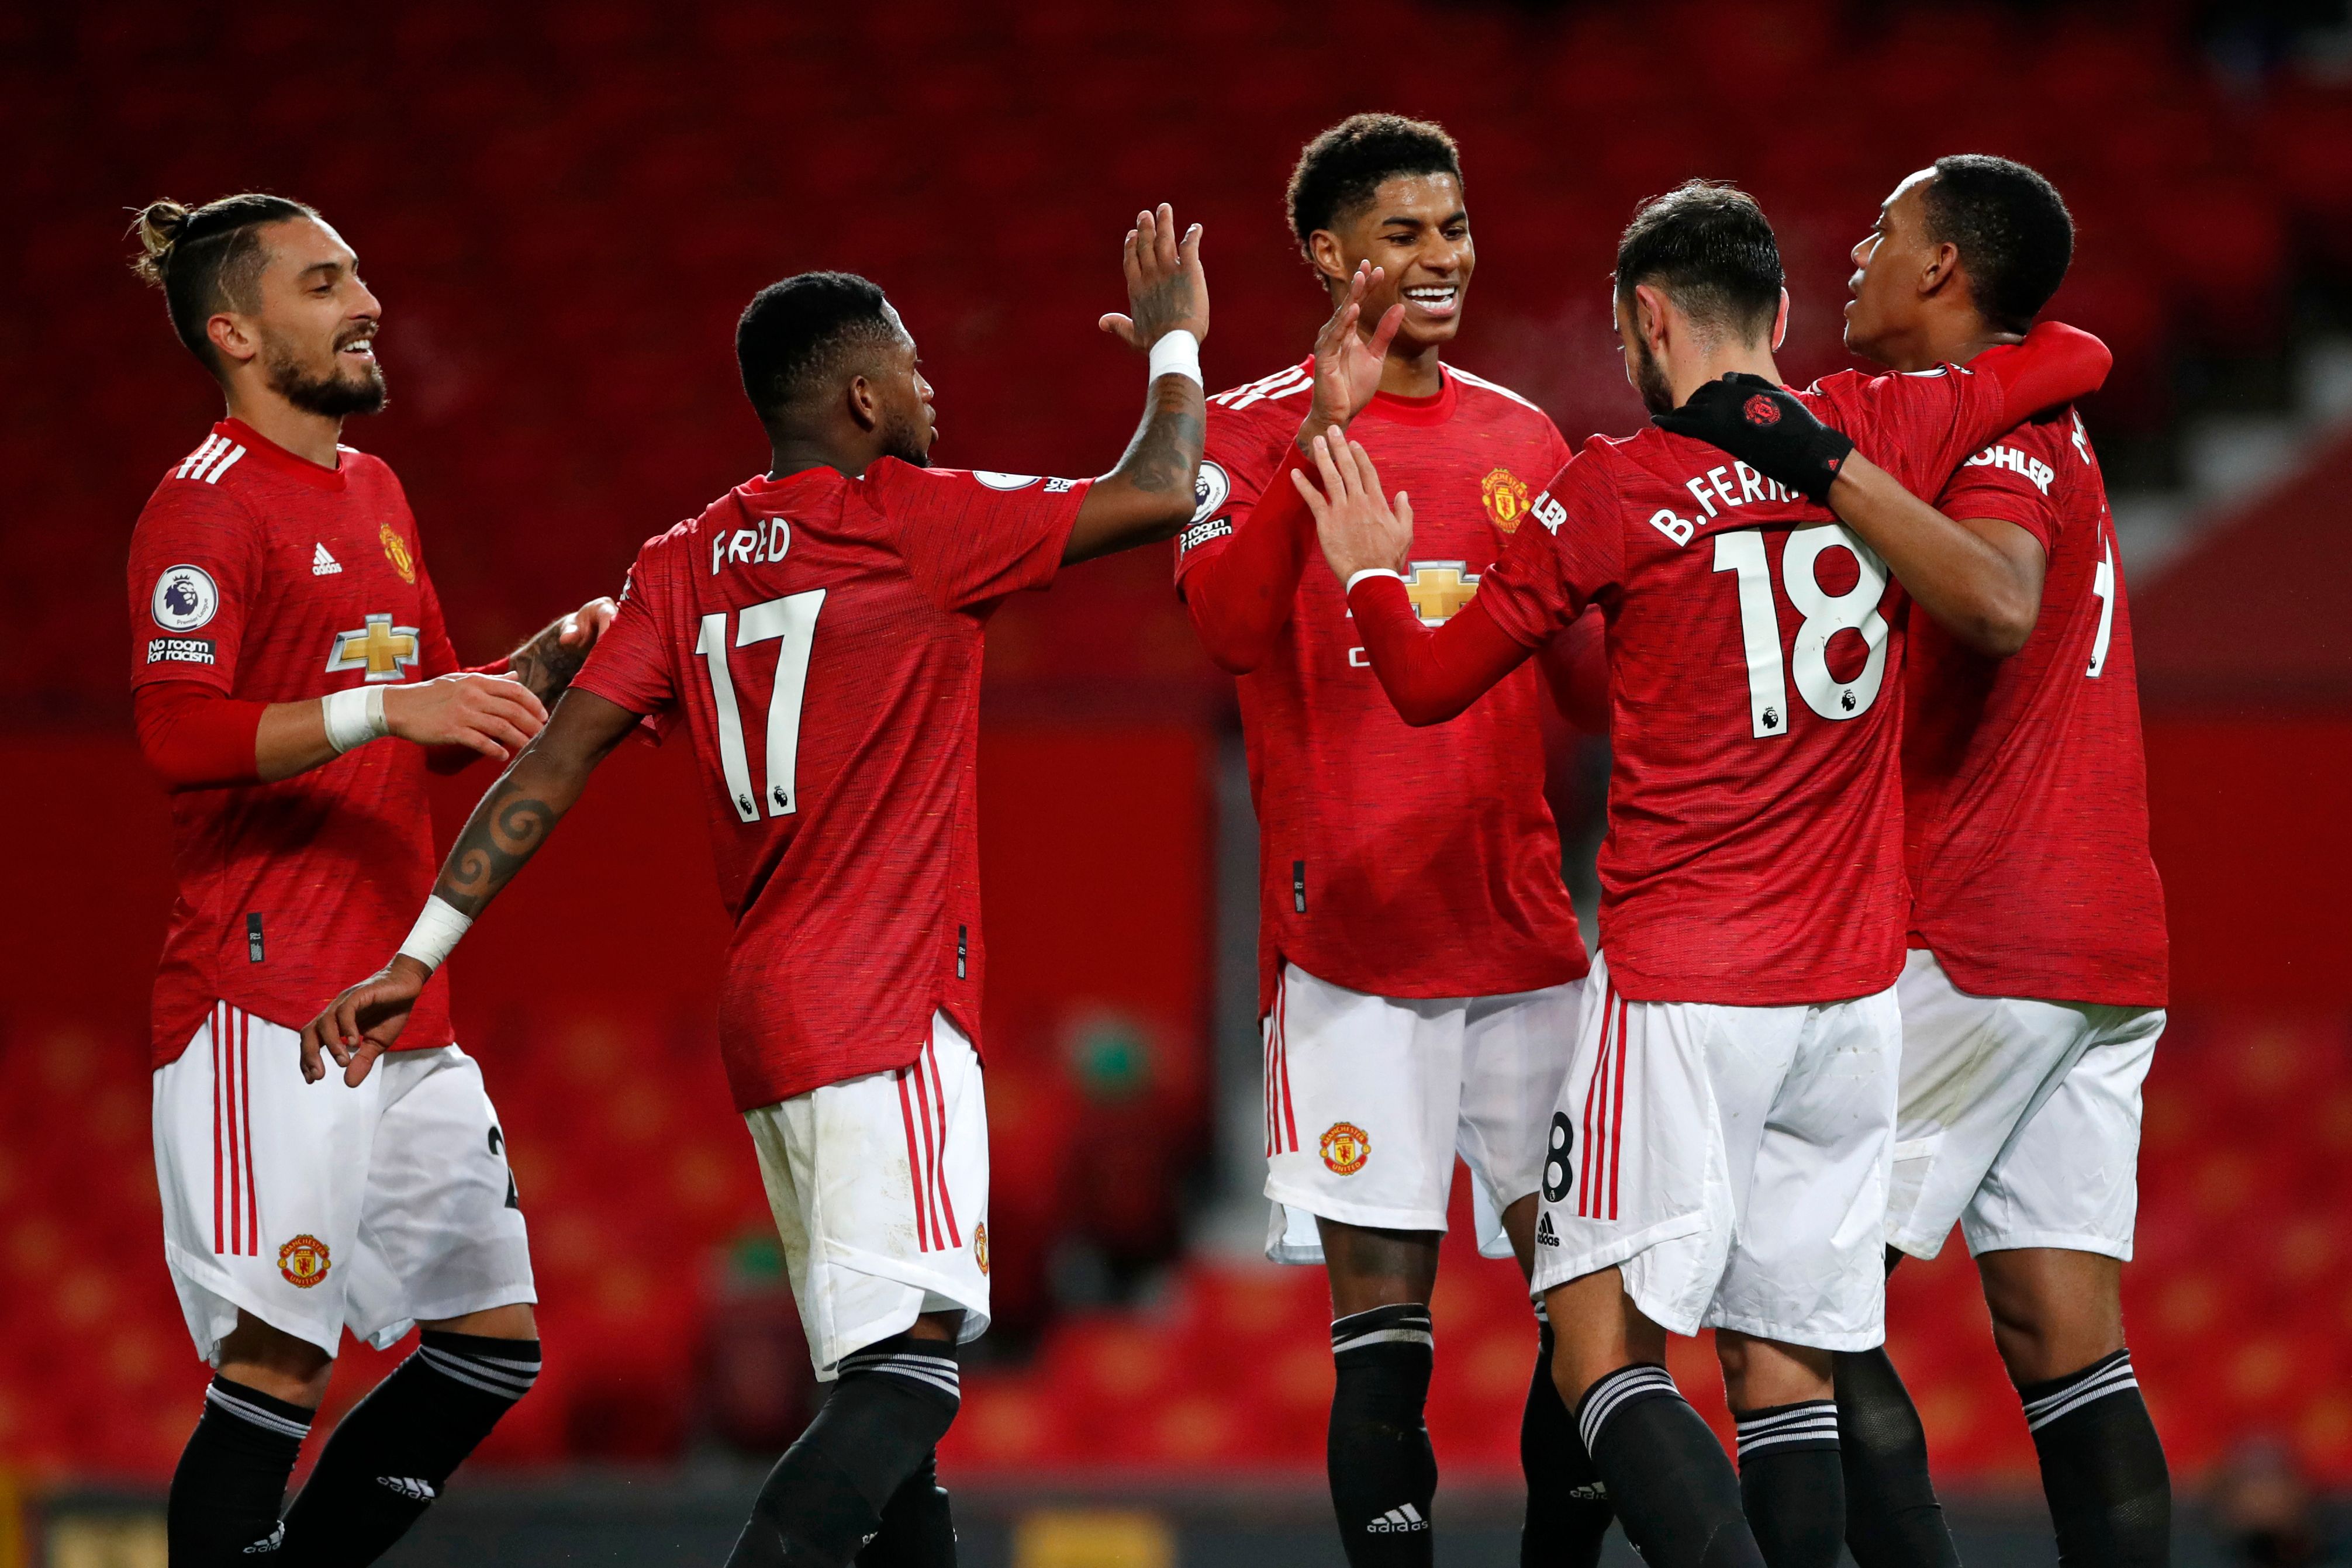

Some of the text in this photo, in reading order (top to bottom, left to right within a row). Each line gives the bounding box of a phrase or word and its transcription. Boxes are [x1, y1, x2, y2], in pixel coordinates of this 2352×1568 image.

[1963, 445, 2054, 496] OHLER
[1531, 490, 1567, 536] LER
[1188, 519, 1225, 537] room
[1188, 526, 1232, 548] racism
[712, 517, 790, 576] FRED
[312, 562, 343, 576] adidas
[1712, 521, 1887, 739] 18
[148, 639, 209, 652] No room
[165, 650, 214, 665] racism
[695, 588, 827, 823] 17
[1324, 1127, 1365, 1145] MANCHESTER
[1542, 1111, 1573, 1203] 8
[1332, 1162, 1360, 1172] UNITED
[283, 1239, 326, 1255] MANCHESTER
[290, 1275, 319, 1284] UNITED
[375, 1476, 431, 1503] adida
[1367, 1521, 1428, 1532] adidas
